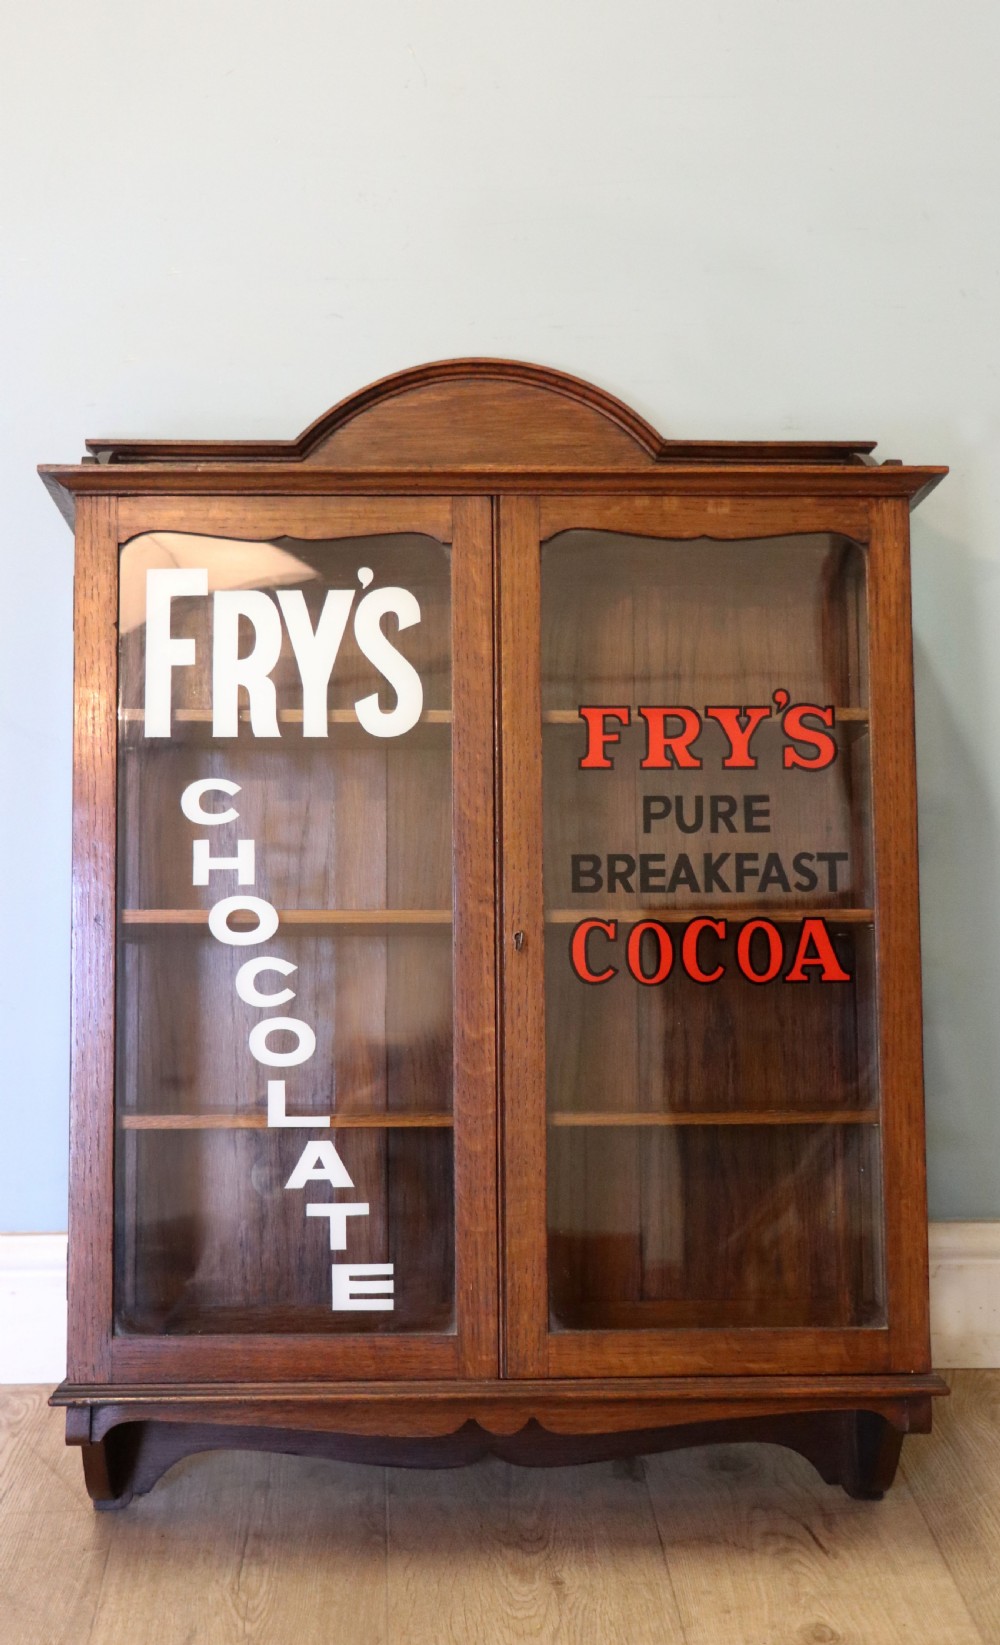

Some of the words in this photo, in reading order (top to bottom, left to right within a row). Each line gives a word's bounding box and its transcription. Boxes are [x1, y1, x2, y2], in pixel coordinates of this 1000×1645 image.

[144, 566, 424, 738] FRY'S
[578, 688, 838, 772] FRY'S
[642, 794, 771, 834] PURE
[570, 852, 849, 894] BREAKFAST
[569, 916, 851, 985] COCOA
[180, 778, 395, 1311] CHOCOLATE
